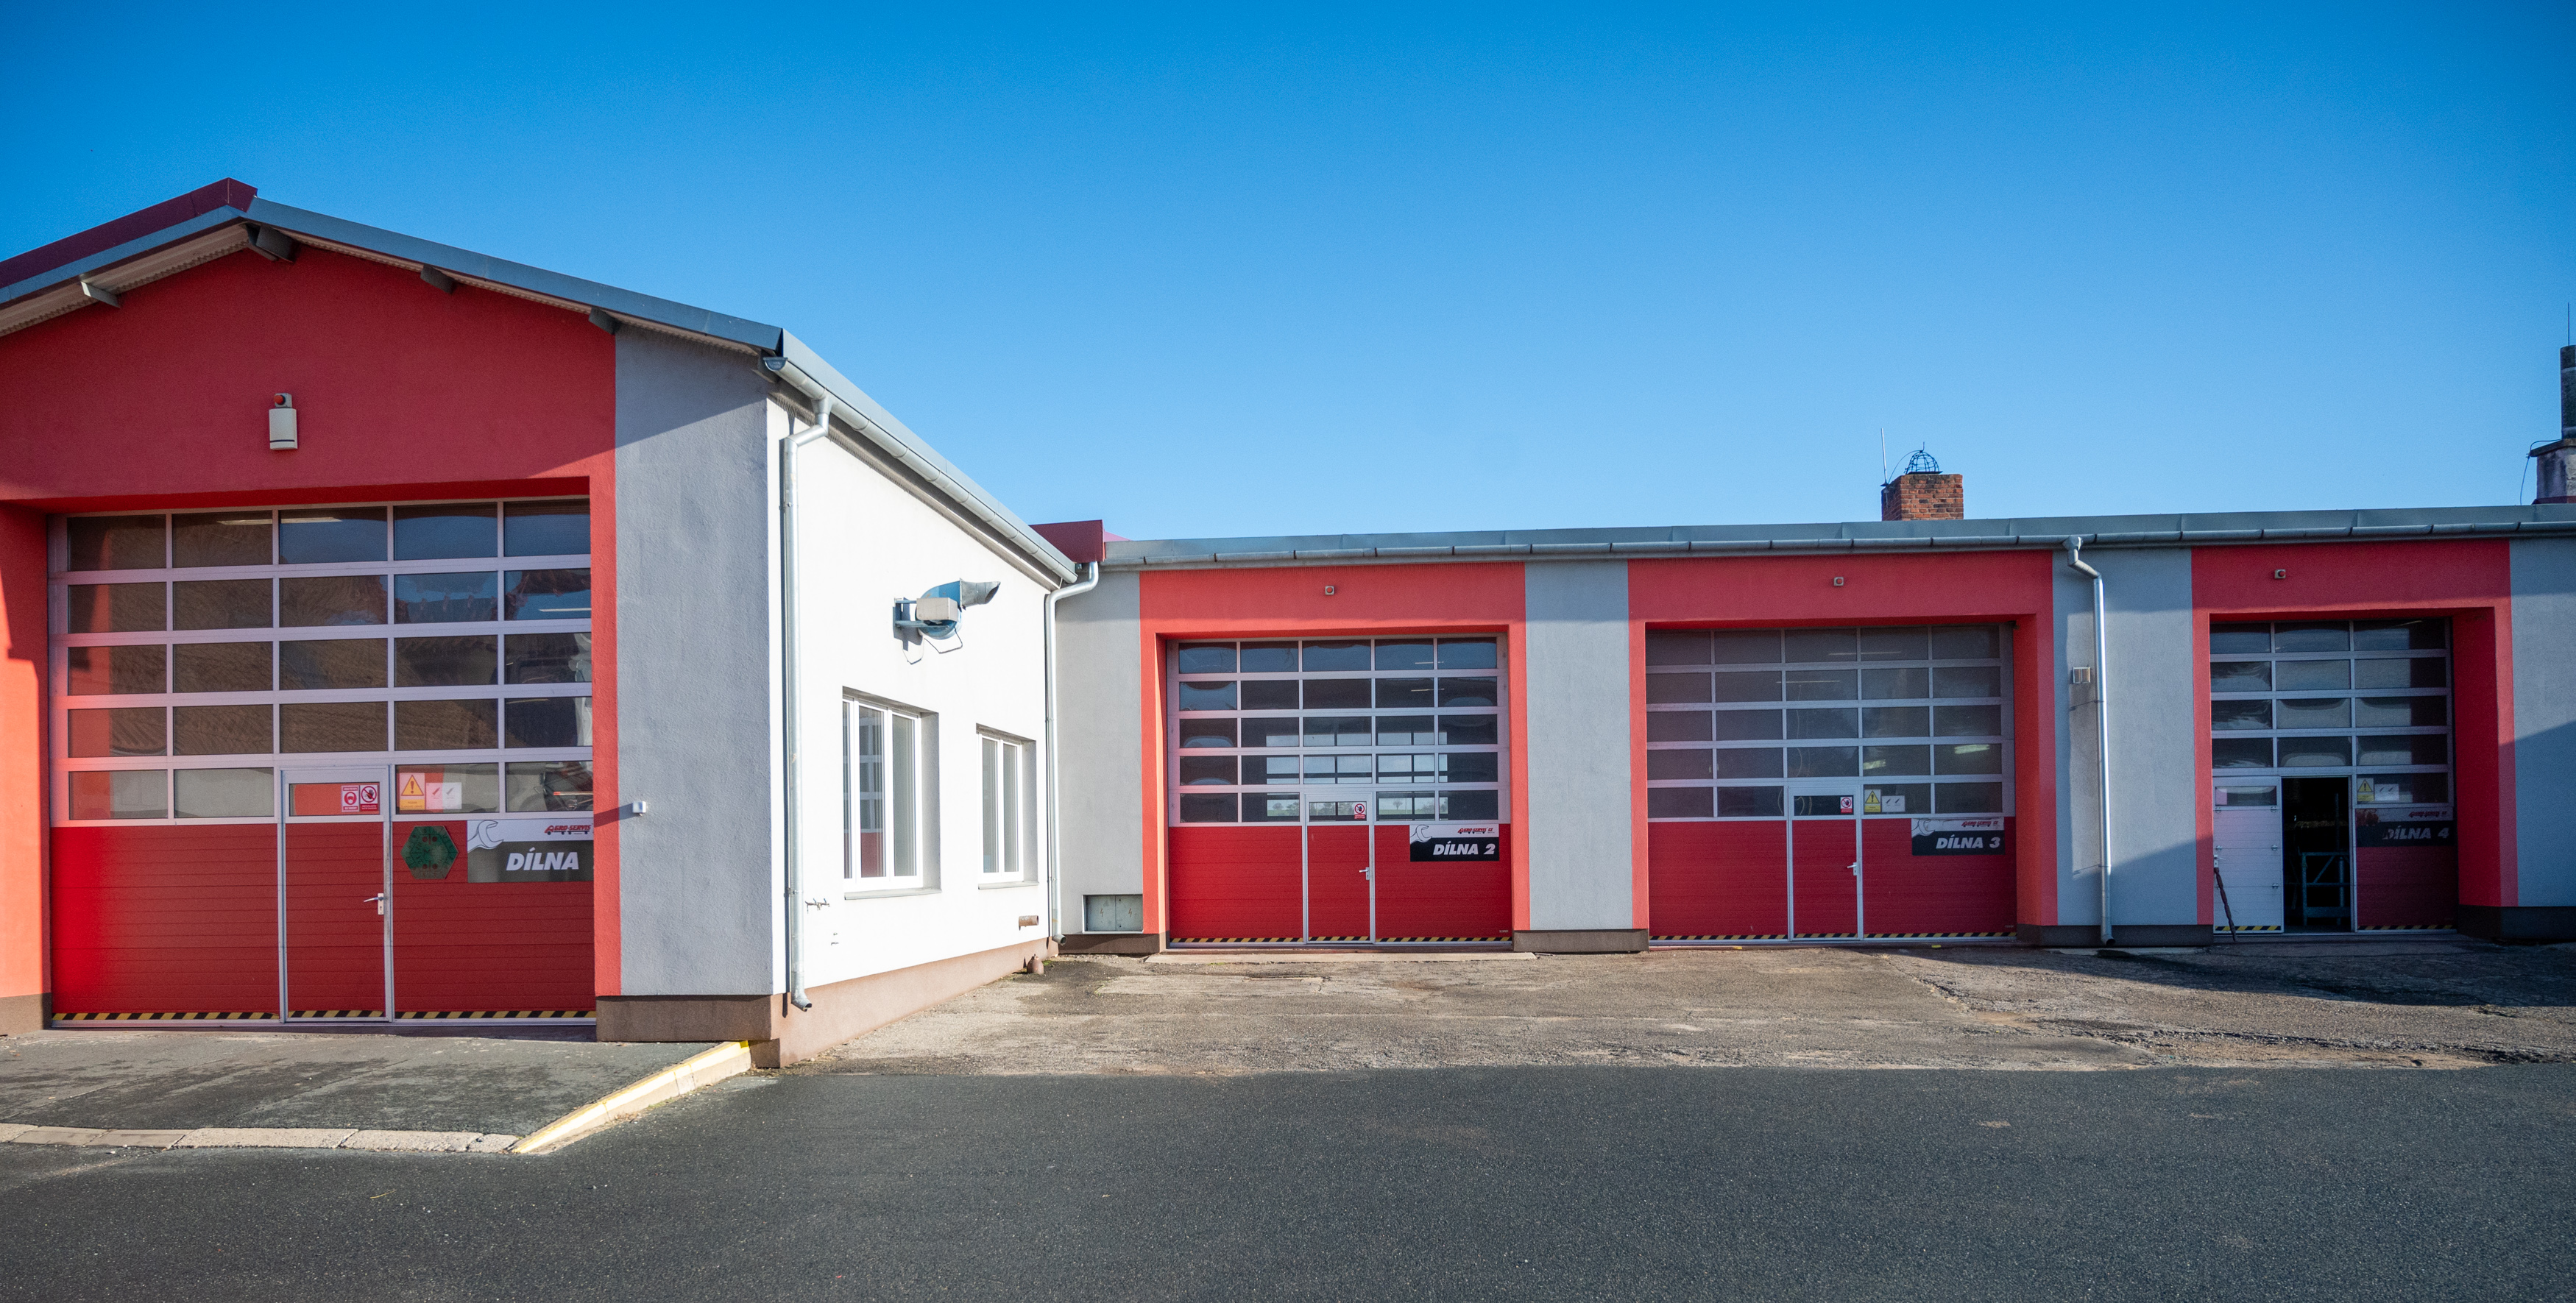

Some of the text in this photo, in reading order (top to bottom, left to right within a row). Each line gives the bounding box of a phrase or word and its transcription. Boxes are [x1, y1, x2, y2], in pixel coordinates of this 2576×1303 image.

[544, 825, 591, 834] AGRO-SERVIS
[2382, 825, 2449, 839] DÍLNA 4
[1432, 840, 1496, 855] DÍLNA 2
[1936, 834, 2000, 848] DÍLNA 3
[506, 847, 579, 870] DÍLNA
